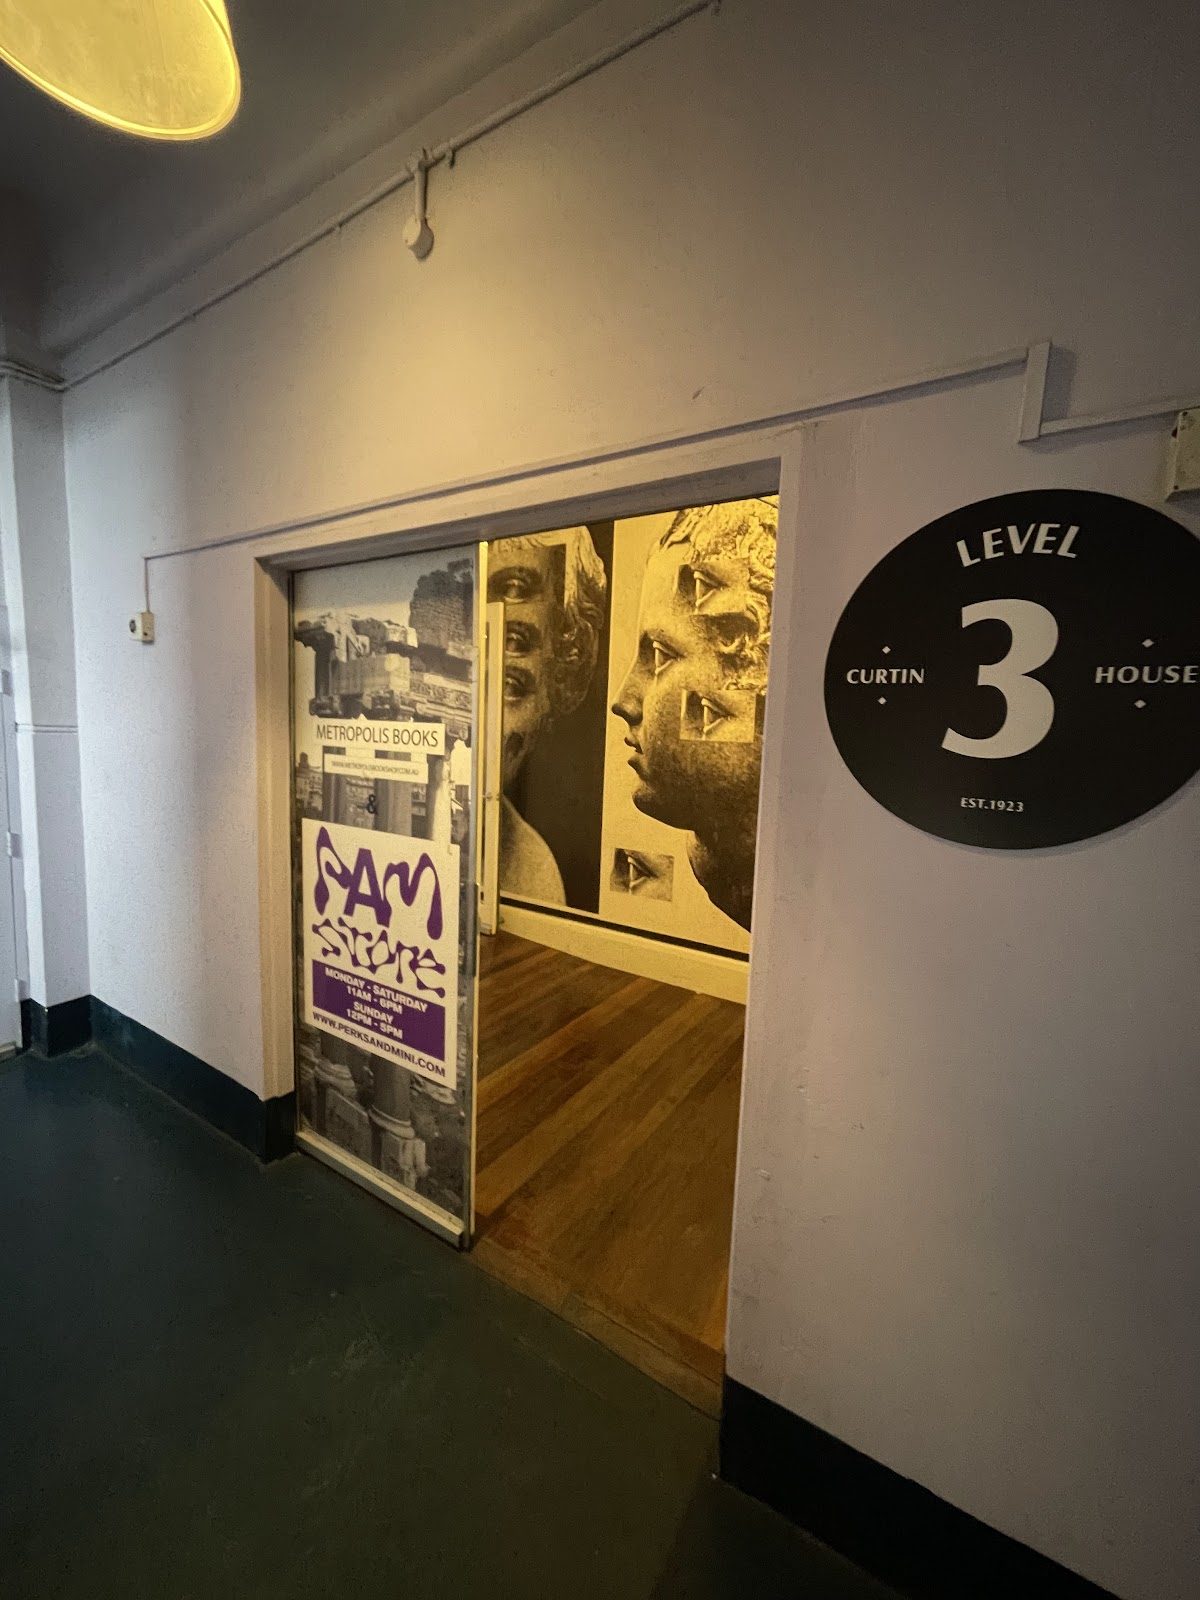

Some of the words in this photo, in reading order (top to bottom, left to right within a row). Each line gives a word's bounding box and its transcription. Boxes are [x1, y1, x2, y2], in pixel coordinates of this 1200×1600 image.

[956, 523, 1080, 567] LEVEL
[846, 668, 925, 684] CURTIN
[1095, 665, 1199, 684] HOUSE
[941, 598, 1059, 759] 3
[316, 724, 389, 744] METROPOLIS
[393, 729, 438, 747] BOOKS
[367, 794, 376, 814] &
[960, 797, 1024, 812] EST.1923
[325, 967, 365, 989] MONDAY
[373, 985, 428, 1013] SATURDAY
[347, 985, 372, 1002] 11AM
[380, 998, 403, 1014] 6PM
[346, 1008, 372, 1026] 12PM
[353, 1001, 394, 1024] SUNDAY
[312, 1012, 446, 1078] WWW.PERKSANDMINI.COM
